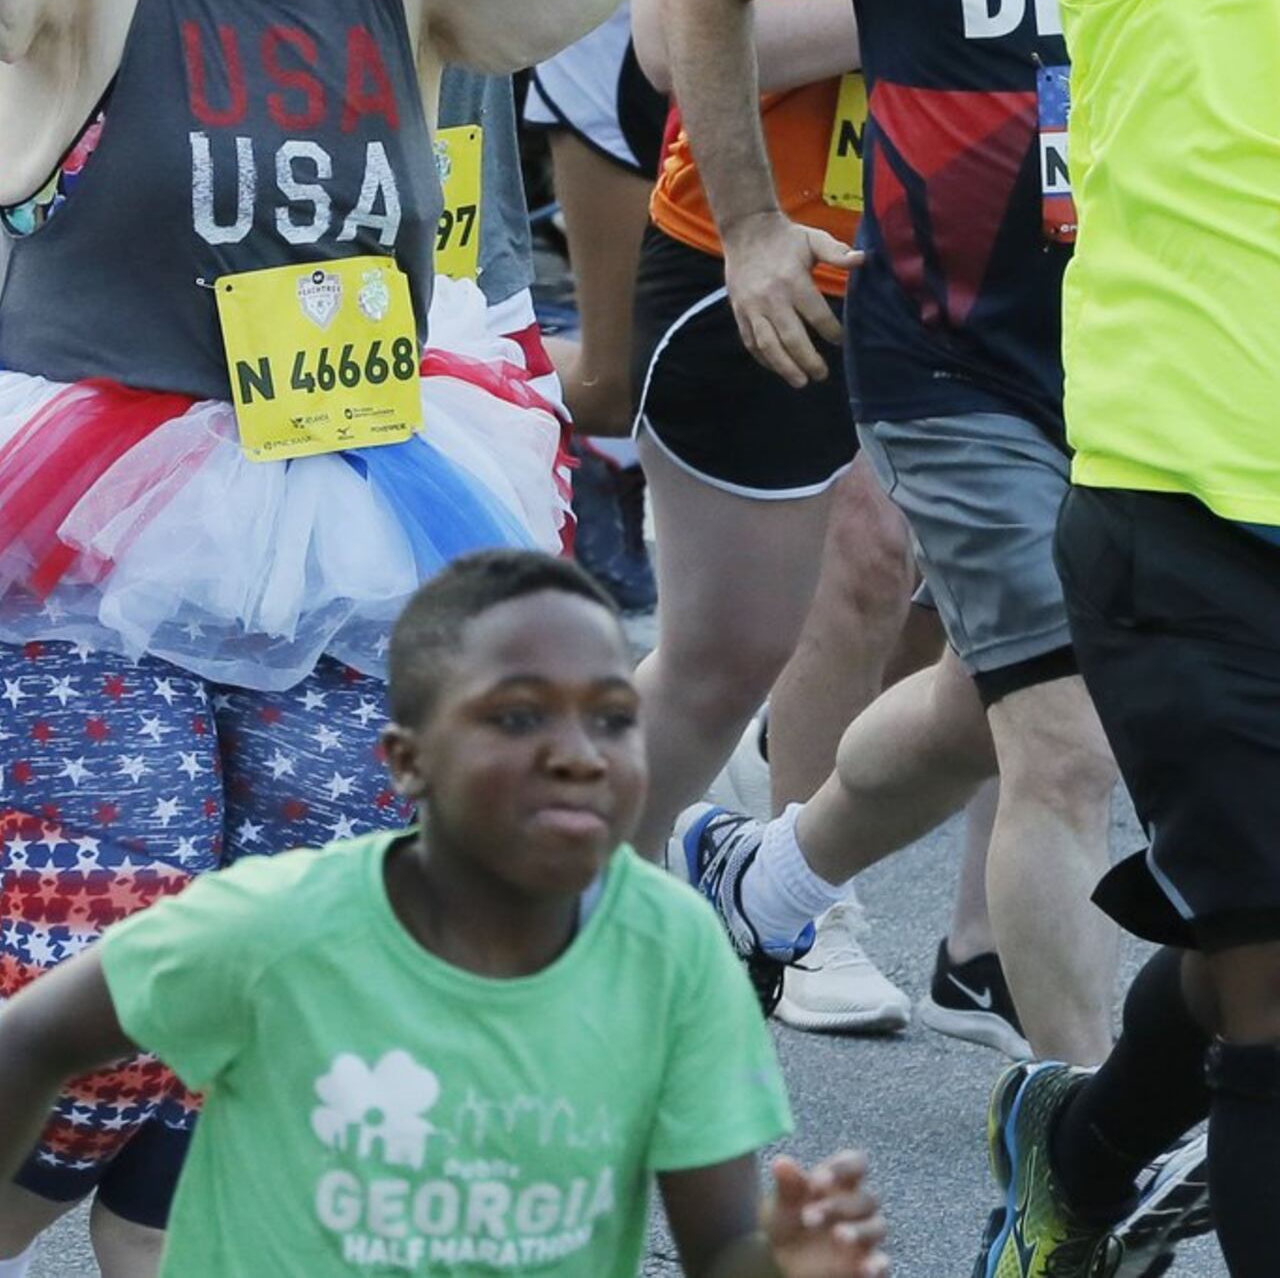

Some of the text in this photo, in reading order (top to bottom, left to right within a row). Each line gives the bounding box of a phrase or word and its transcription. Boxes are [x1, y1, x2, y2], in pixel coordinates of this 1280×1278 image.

[182, 20, 400, 134] USA
[188, 131, 402, 247] USA
[235, 336, 415, 406] N 46668
[314, 1166, 616, 1239] GEORGIA
[343, 1232, 424, 1269] HALF
